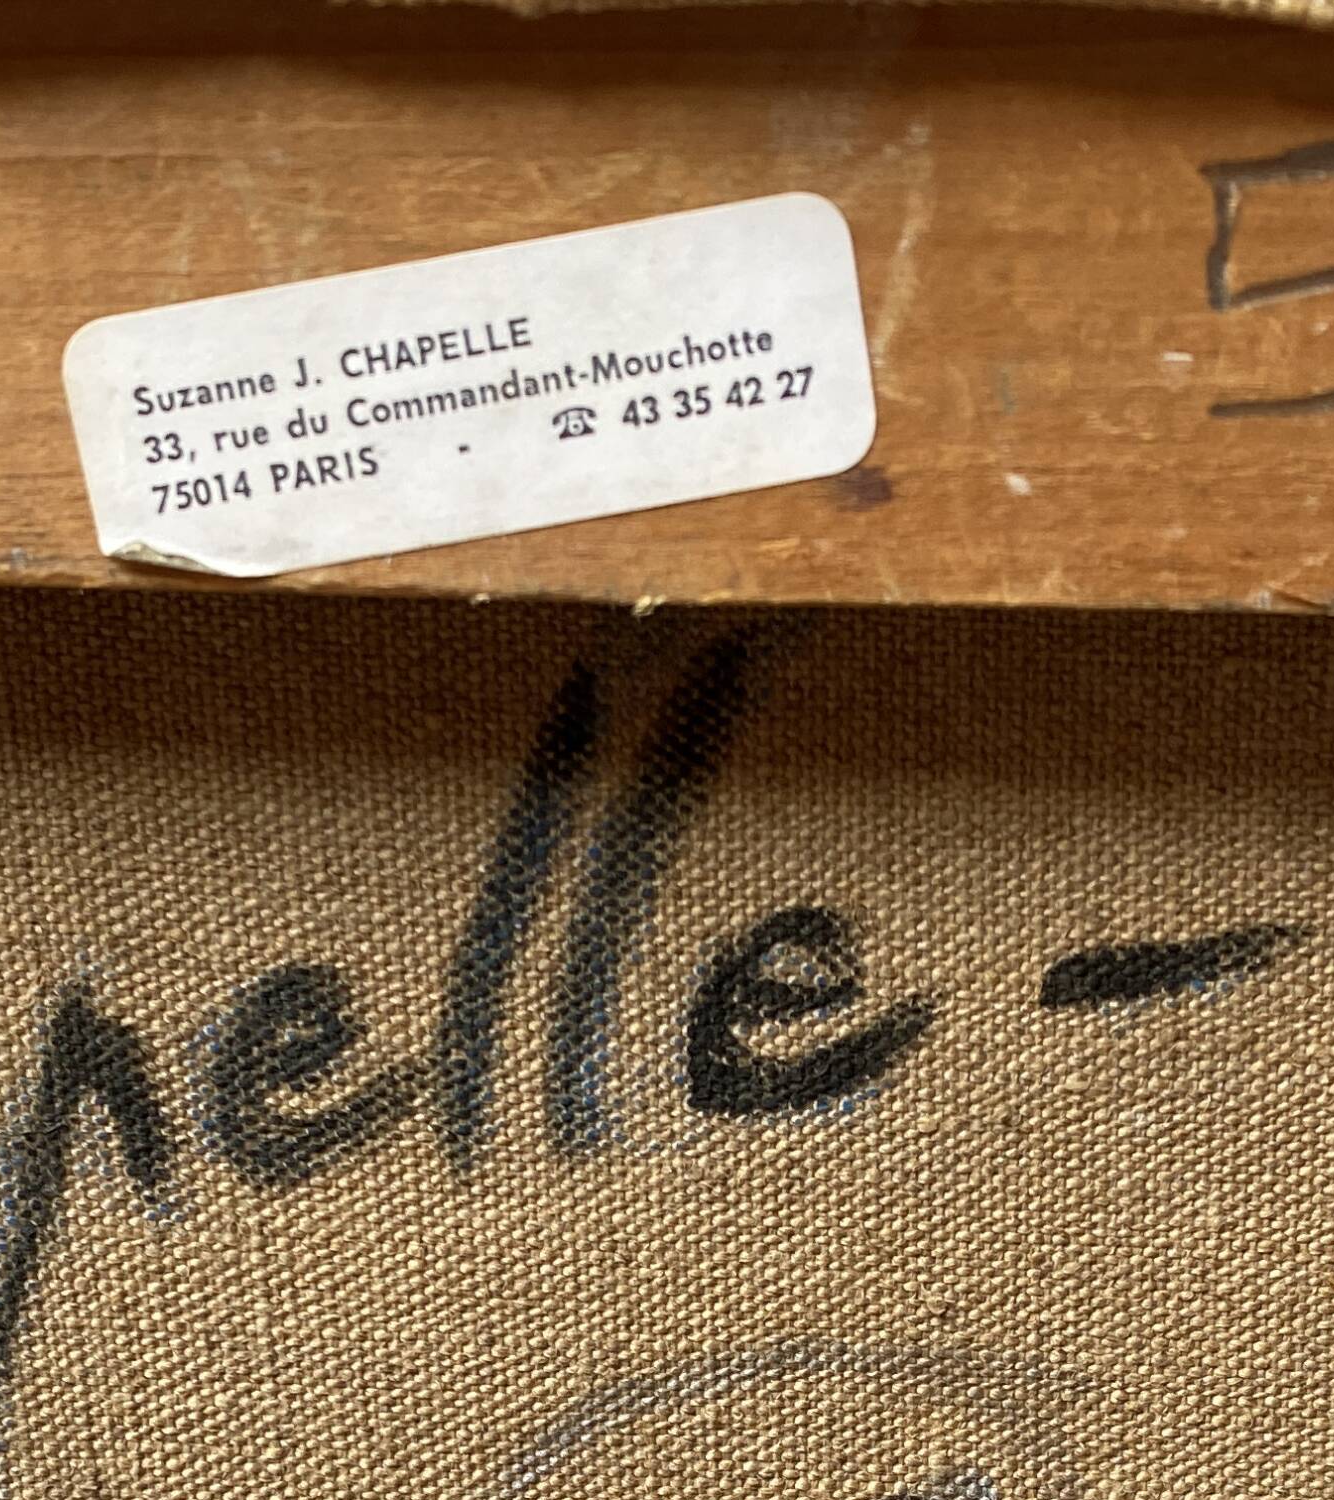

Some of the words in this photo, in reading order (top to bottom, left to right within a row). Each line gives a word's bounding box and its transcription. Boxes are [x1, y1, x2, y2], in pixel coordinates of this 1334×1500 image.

[133, 372, 276, 416] Suzanne
[294, 357, 323, 388] J.
[340, 316, 532, 378] CHAPELLE
[143, 432, 196, 464] 33,
[213, 425, 269, 451] rue
[286, 408, 328, 439] du
[346, 330, 773, 428] Commandant-Mouchotte
[152, 471, 252, 514] 75014
[269, 446, 380, 493] PARIS
[622, 395, 661, 427] 43
[674, 386, 712, 419] 35
[725, 376, 764, 408] 42
[776, 366, 813, 400] 27
